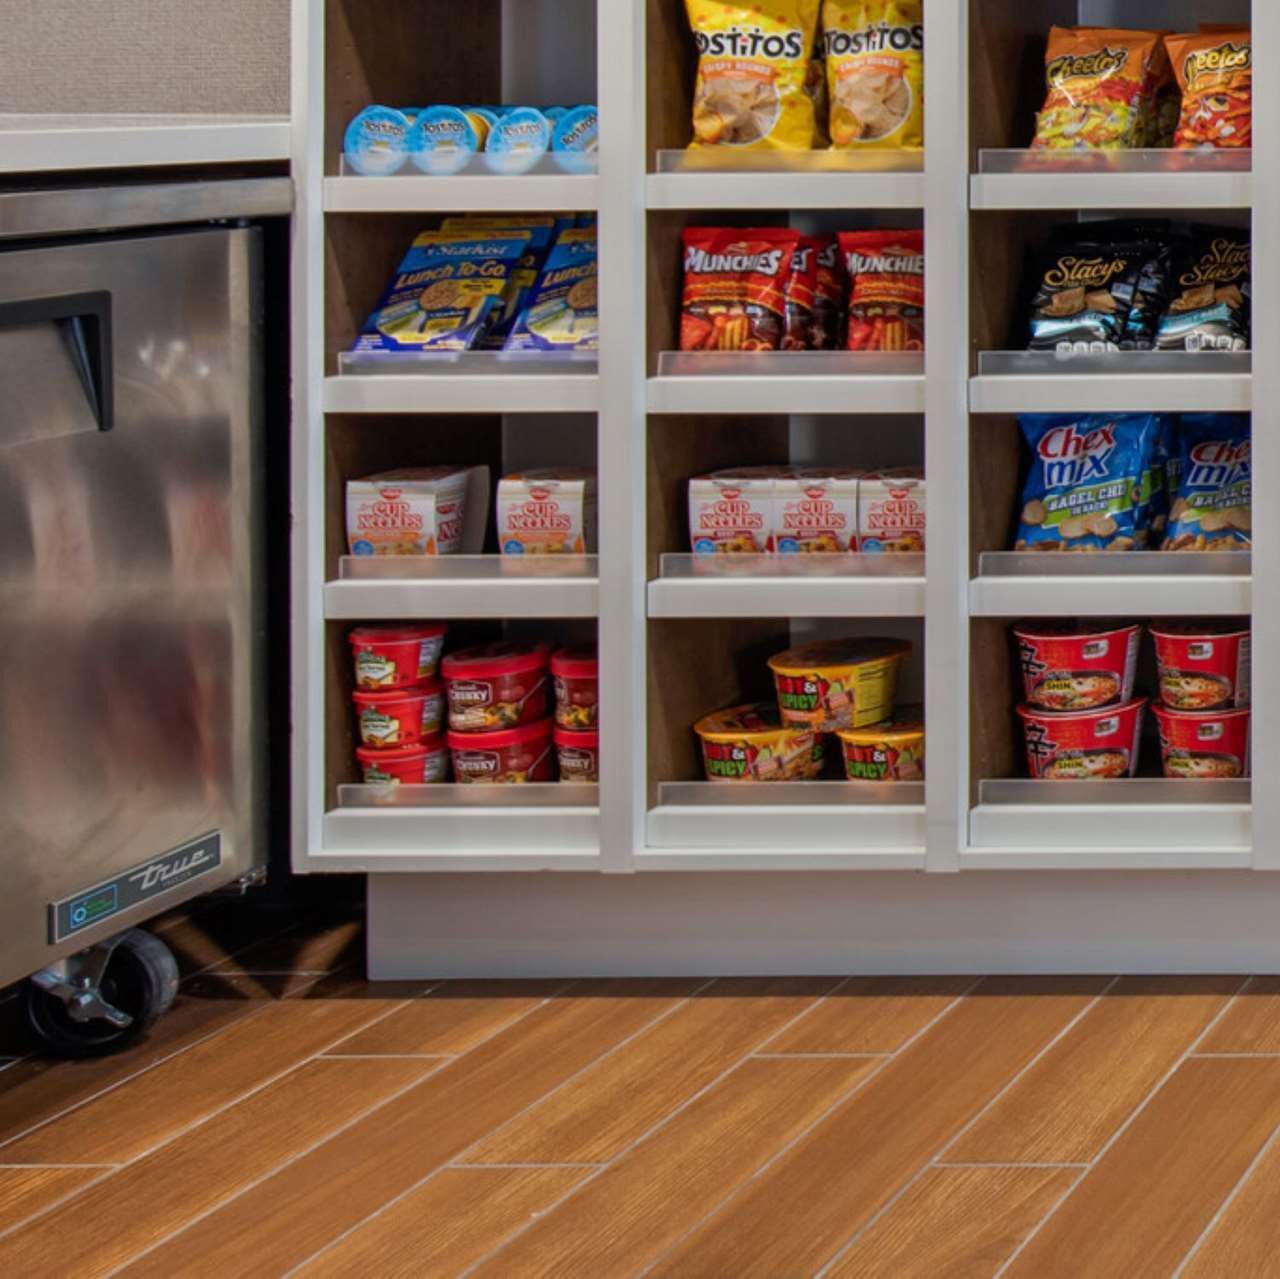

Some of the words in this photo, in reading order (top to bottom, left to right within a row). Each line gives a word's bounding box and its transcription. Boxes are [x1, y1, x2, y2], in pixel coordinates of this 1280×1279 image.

[1048, 49, 1128, 81] Cheetos
[685, 246, 782, 275] MUNCHIES
[847, 252, 925, 274] MUNCHIE
[1045, 257, 1127, 287] Stacy's
[1038, 422, 1117, 460] Chex
[1191, 440, 1250, 464] Che
